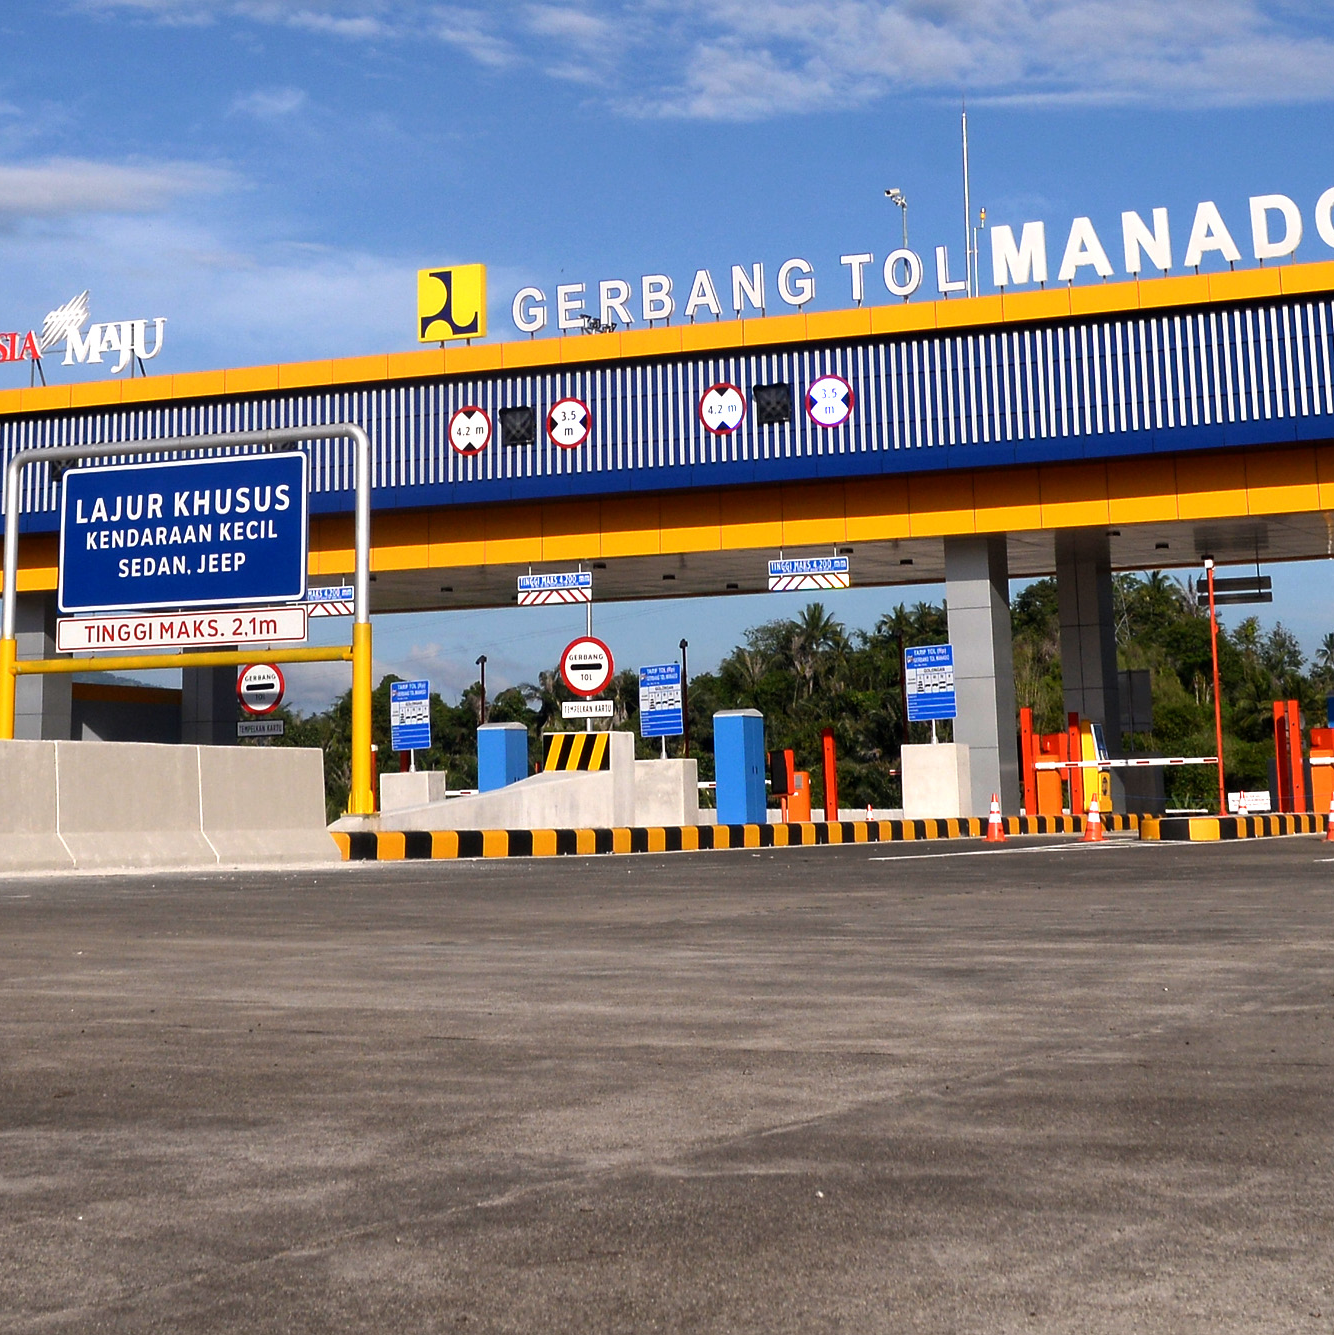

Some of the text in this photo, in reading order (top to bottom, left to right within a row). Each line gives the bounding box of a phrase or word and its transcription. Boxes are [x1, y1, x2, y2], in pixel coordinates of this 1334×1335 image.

[512, 258, 815, 333] GERBANG
[840, 245, 967, 301] TOL
[61, 317, 167, 374] MAJU
[822, 388, 837, 399] 3.5
[708, 404, 737, 415] 4.2 m
[561, 411, 577, 421] 3.5
[456, 426, 485, 436] 4.2 m
[564, 427, 574, 436] m
[75, 484, 291, 525] LAJUR KHUSUS
[86, 520, 278, 550] KENDARAAN KECIL
[197, 552, 246, 573] JEEP
[84, 621, 153, 644] TINGGI
[160, 618, 225, 640] MAKS.
[569, 653, 604, 661] GERBANG
[245, 673, 276, 682] GERBANG
[581, 673, 592, 681] TOL
[255, 693, 266, 701] TOL
[595, 704, 612, 713] KARTU
